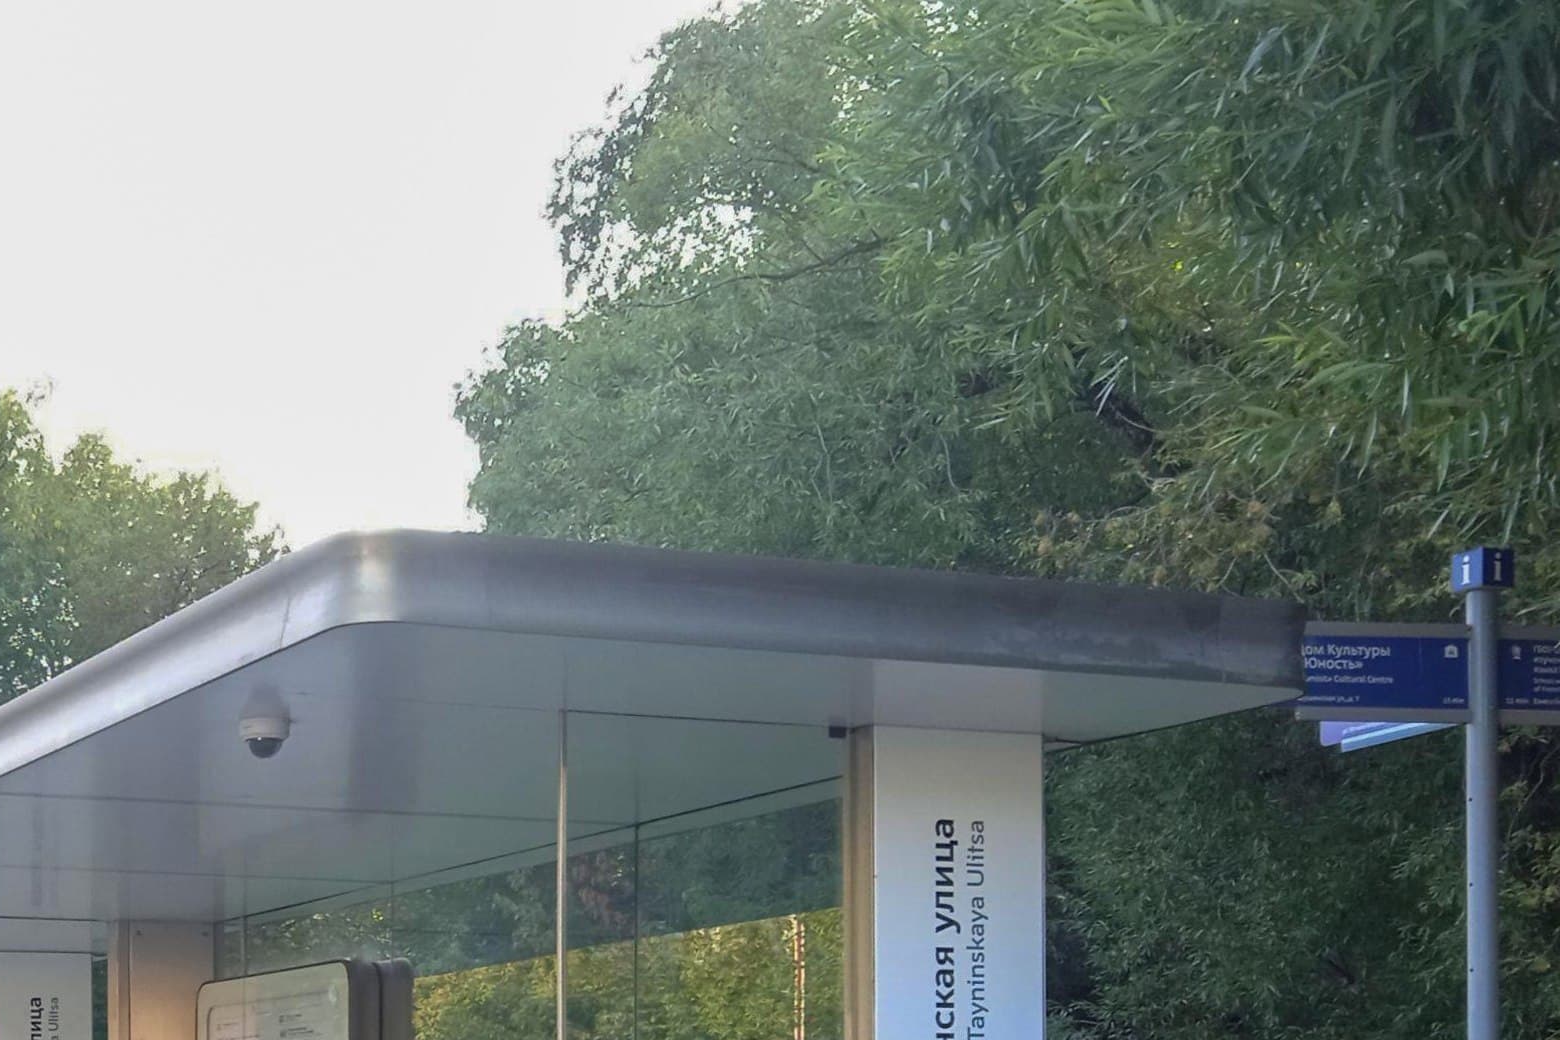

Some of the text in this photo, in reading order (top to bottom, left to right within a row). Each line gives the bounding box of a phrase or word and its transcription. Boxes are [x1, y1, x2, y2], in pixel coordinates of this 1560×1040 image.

[1327, 644, 1391, 659] Культуры
[935, 818, 961, 935] улица
[966, 819, 986, 887] Ulitsa
[48, 997, 60, 1032] Ulitsa
